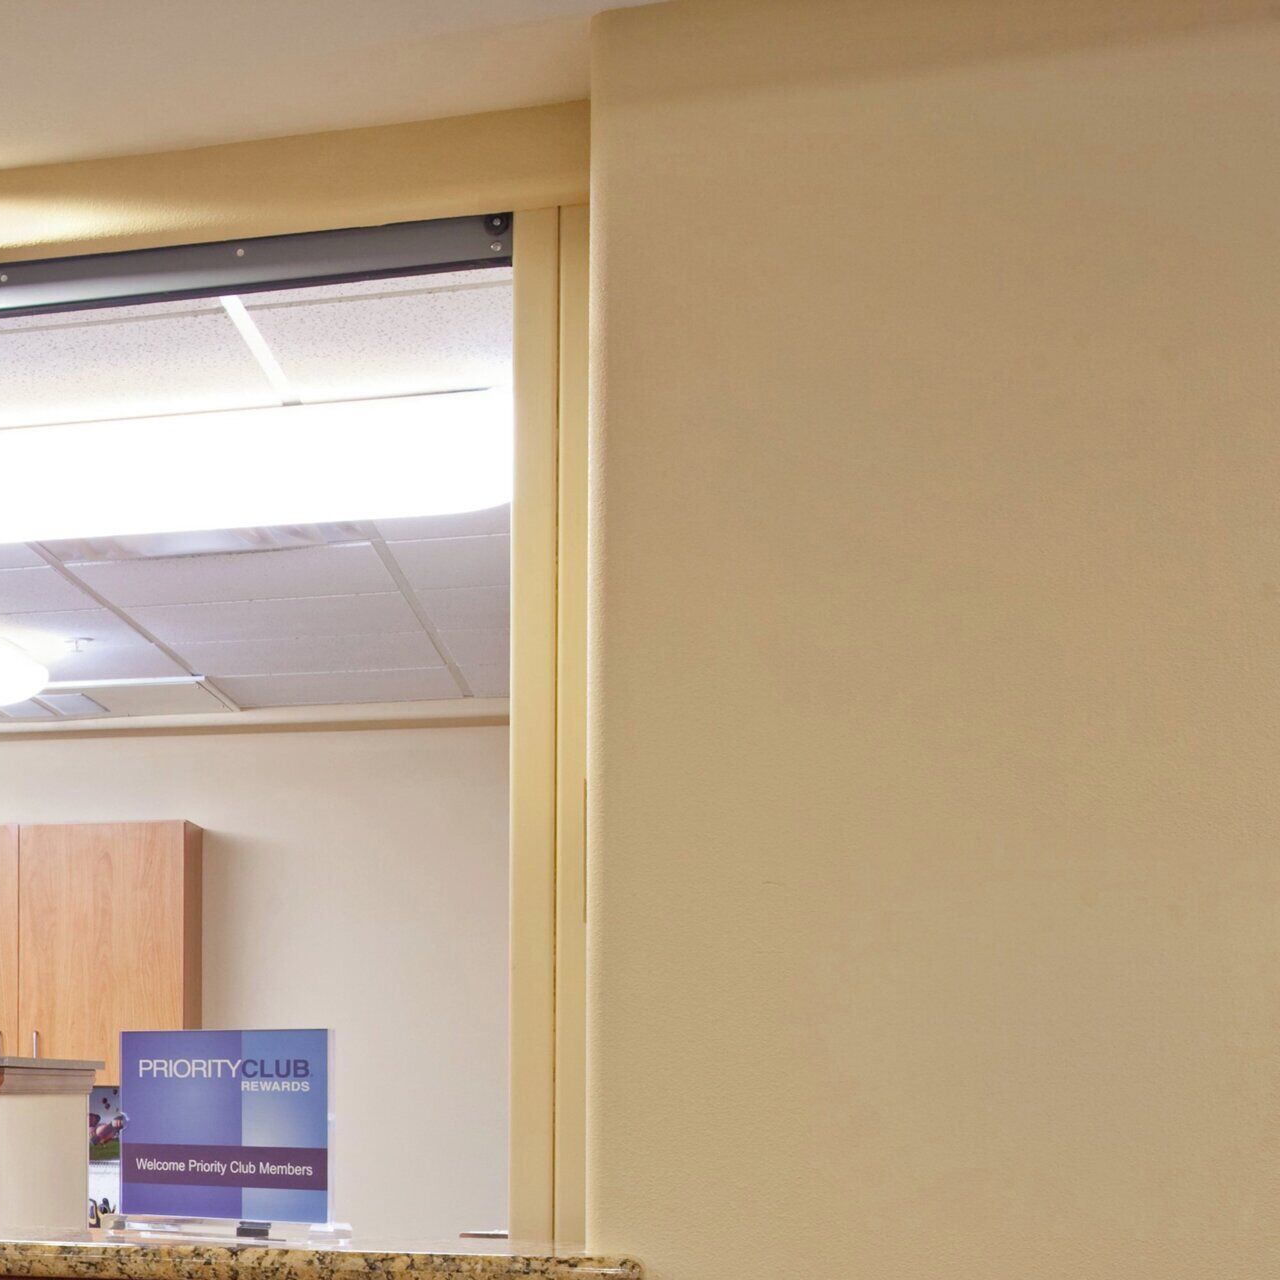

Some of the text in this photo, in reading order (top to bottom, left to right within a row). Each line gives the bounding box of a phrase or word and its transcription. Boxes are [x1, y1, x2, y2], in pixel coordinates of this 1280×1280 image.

[241, 1081, 310, 1092] REWARDS
[136, 1157, 313, 1176] Welcome Priority Club Members
